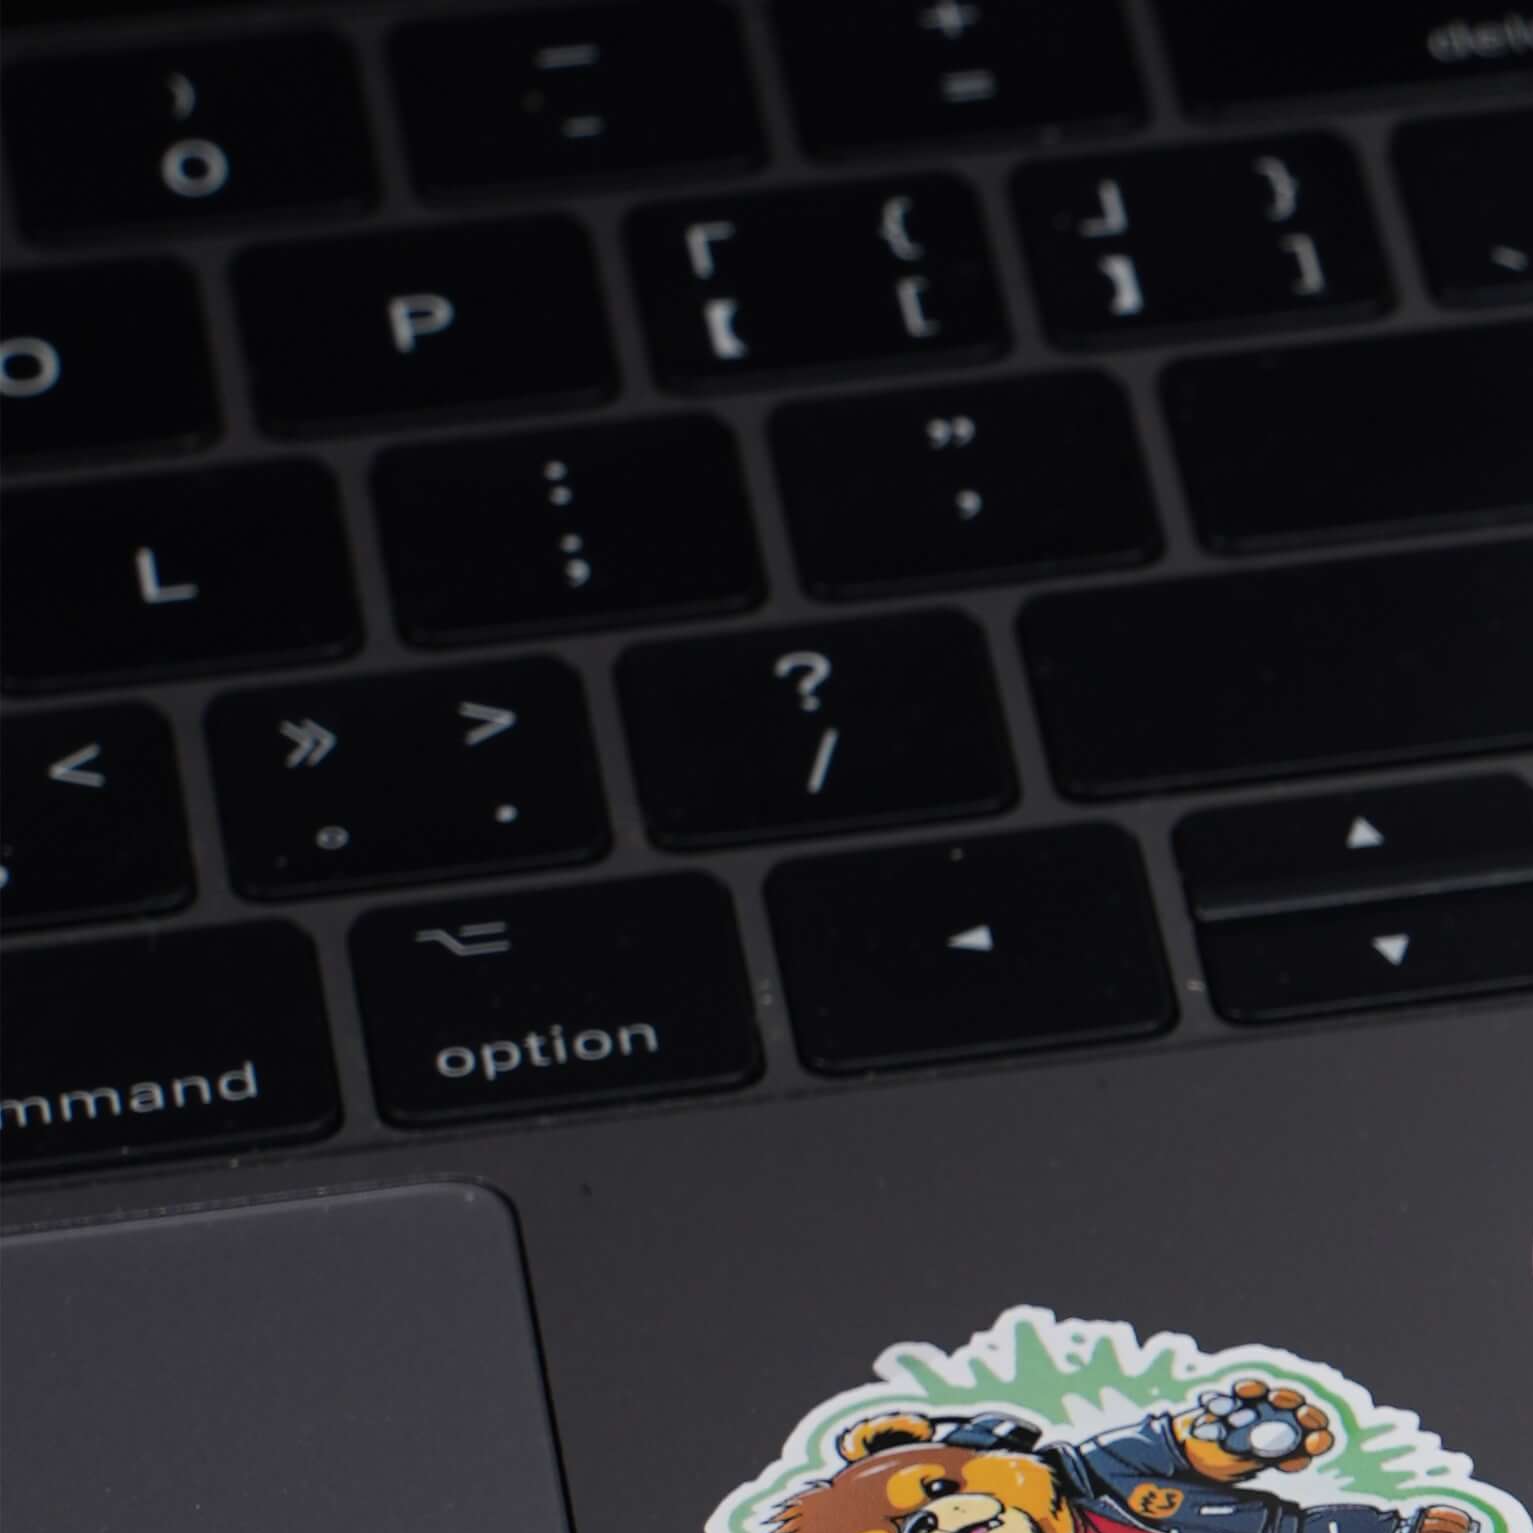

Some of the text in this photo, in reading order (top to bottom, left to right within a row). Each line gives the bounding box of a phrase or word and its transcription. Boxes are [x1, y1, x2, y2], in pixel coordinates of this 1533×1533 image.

[389, 294, 454, 352] P
[136, 548, 197, 603] L
[436, 1020, 659, 1081] option
[0, 1059, 260, 1128] mmand
